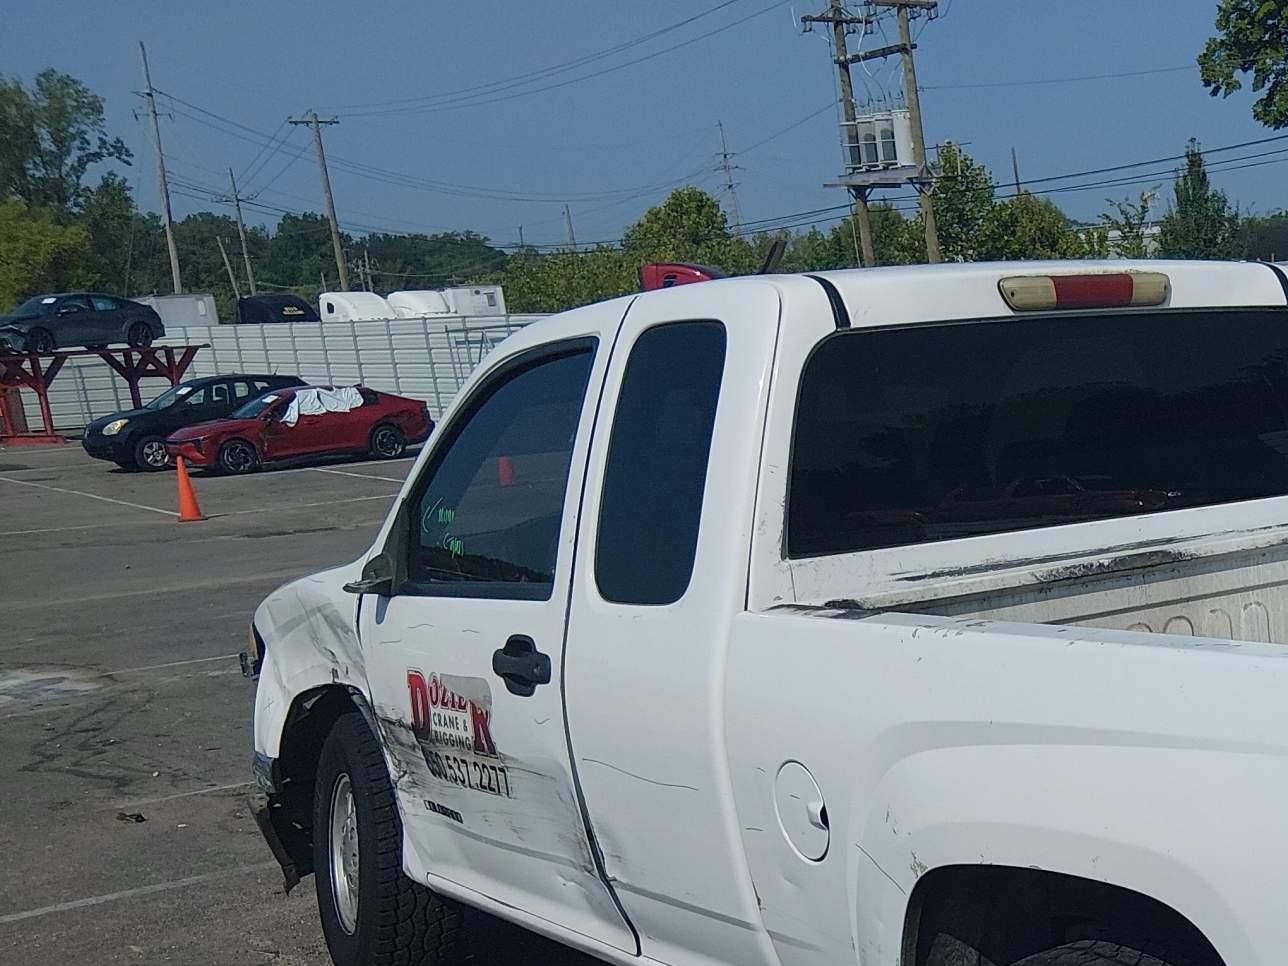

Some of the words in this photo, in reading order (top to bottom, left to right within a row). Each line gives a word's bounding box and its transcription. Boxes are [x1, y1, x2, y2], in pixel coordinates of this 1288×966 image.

[432, 712, 461, 731] CRANE
[463, 721, 469, 733] &
[433, 731, 473, 751] RIGGING
[423, 750, 510, 799] 50.537.2277
